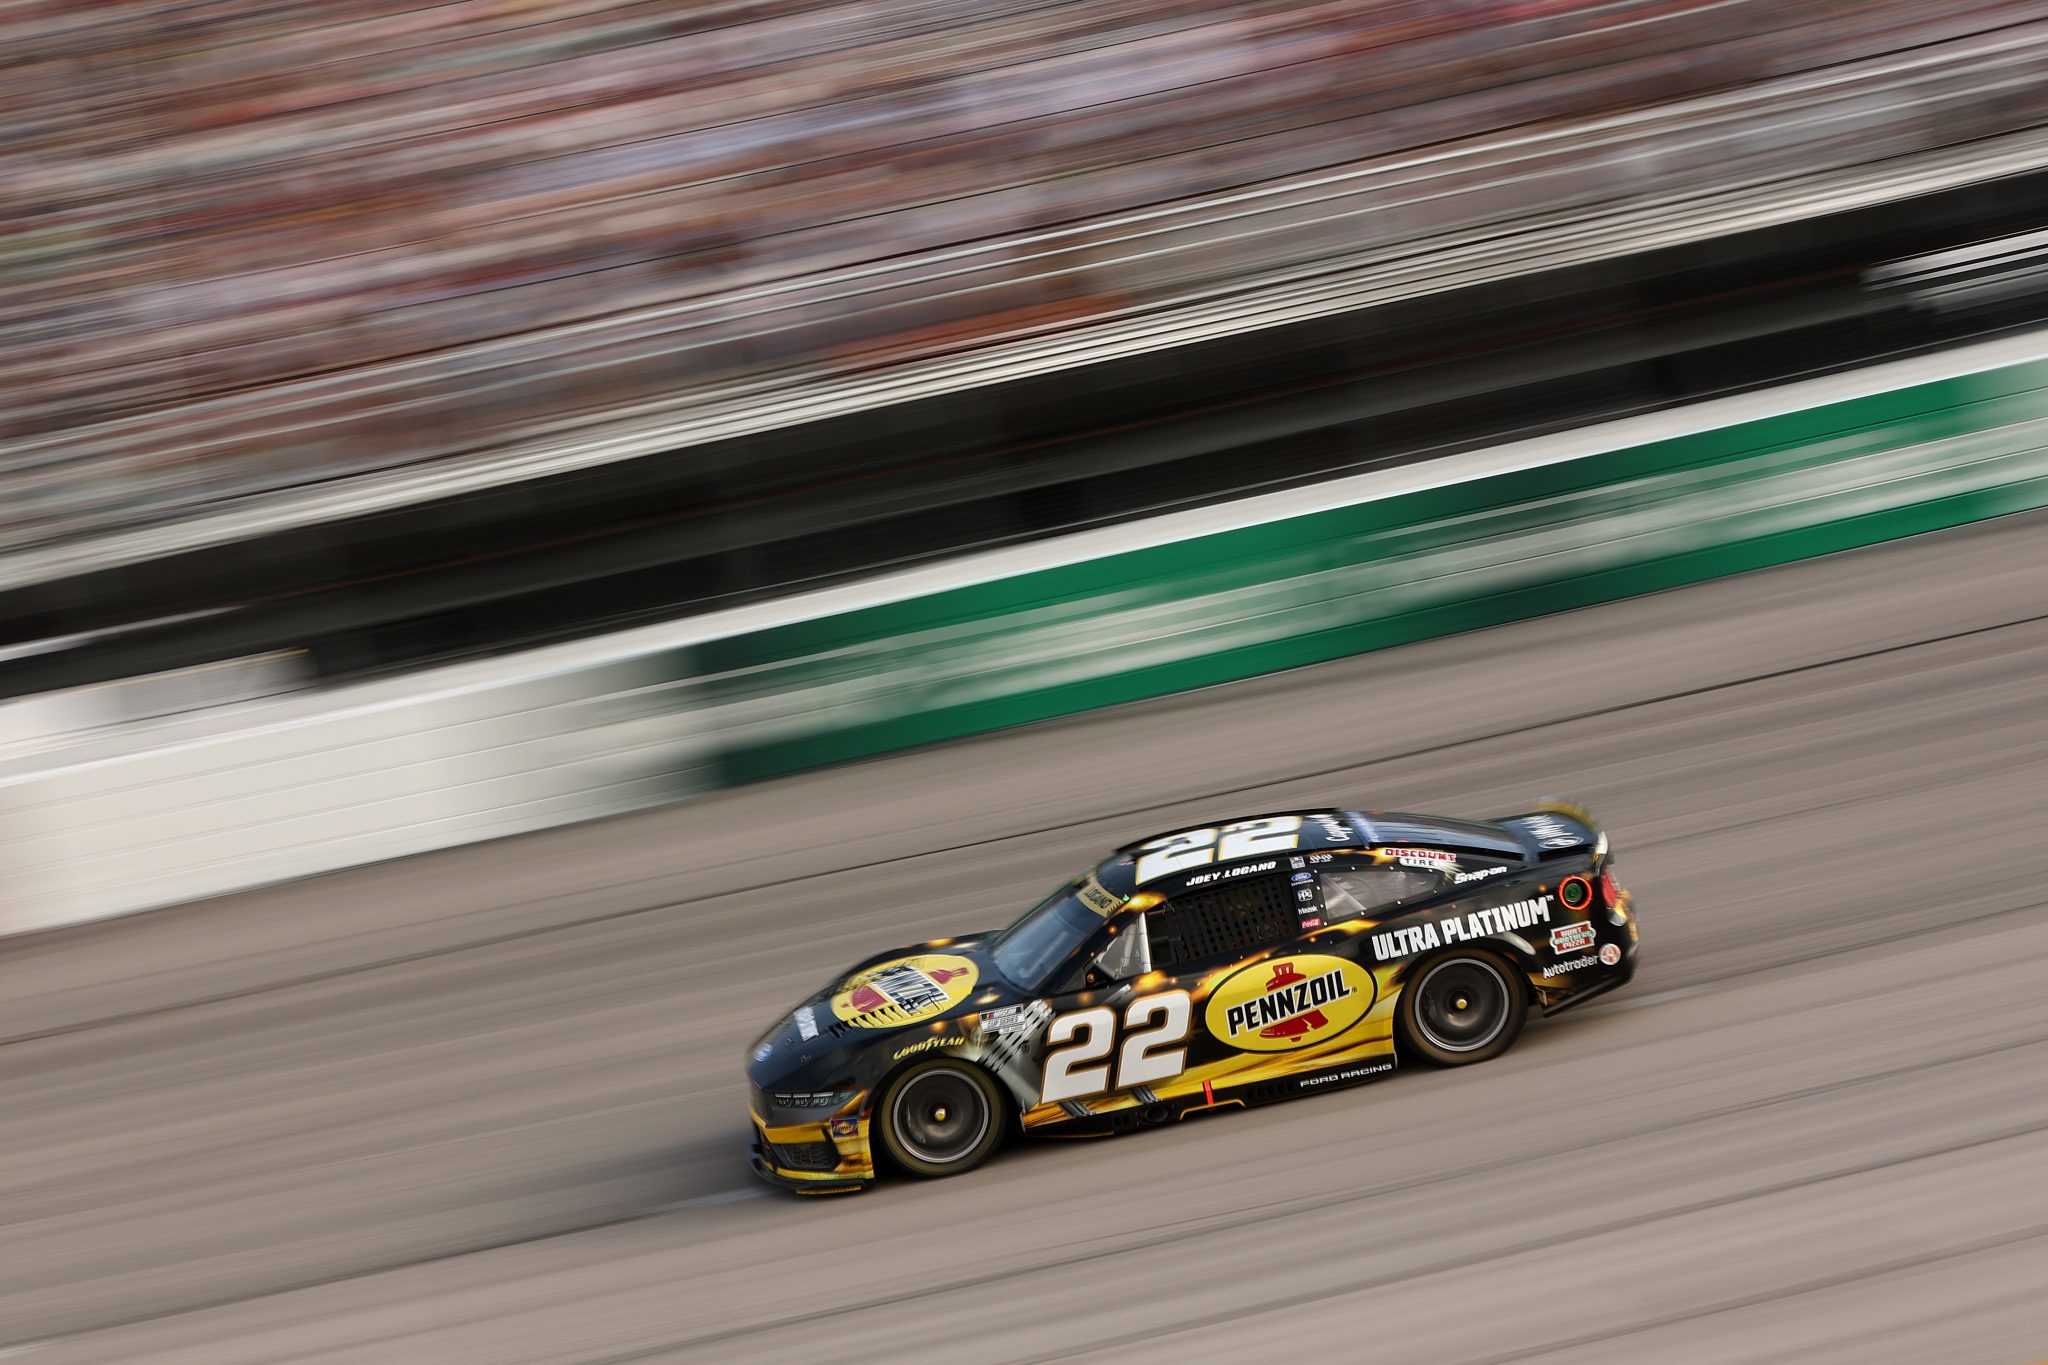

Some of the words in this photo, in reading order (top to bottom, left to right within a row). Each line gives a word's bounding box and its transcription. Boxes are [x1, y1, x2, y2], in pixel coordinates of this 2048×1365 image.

[1384, 848, 1456, 862] DISCOUNT
[1405, 858, 1436, 867] TIRE
[1186, 872, 1221, 887] JOEY
[1223, 861, 1277, 878] LOGANO
[1454, 866, 1508, 885] Snap-on
[1371, 923, 1441, 961] ULTRA
[1542, 955, 1599, 980] Autotrader
[893, 1035, 966, 1061] GOODYEAR
[1040, 988, 1193, 1106] 22
[1300, 1075, 1339, 1087] FORD
[1341, 1063, 1392, 1080] RACING
